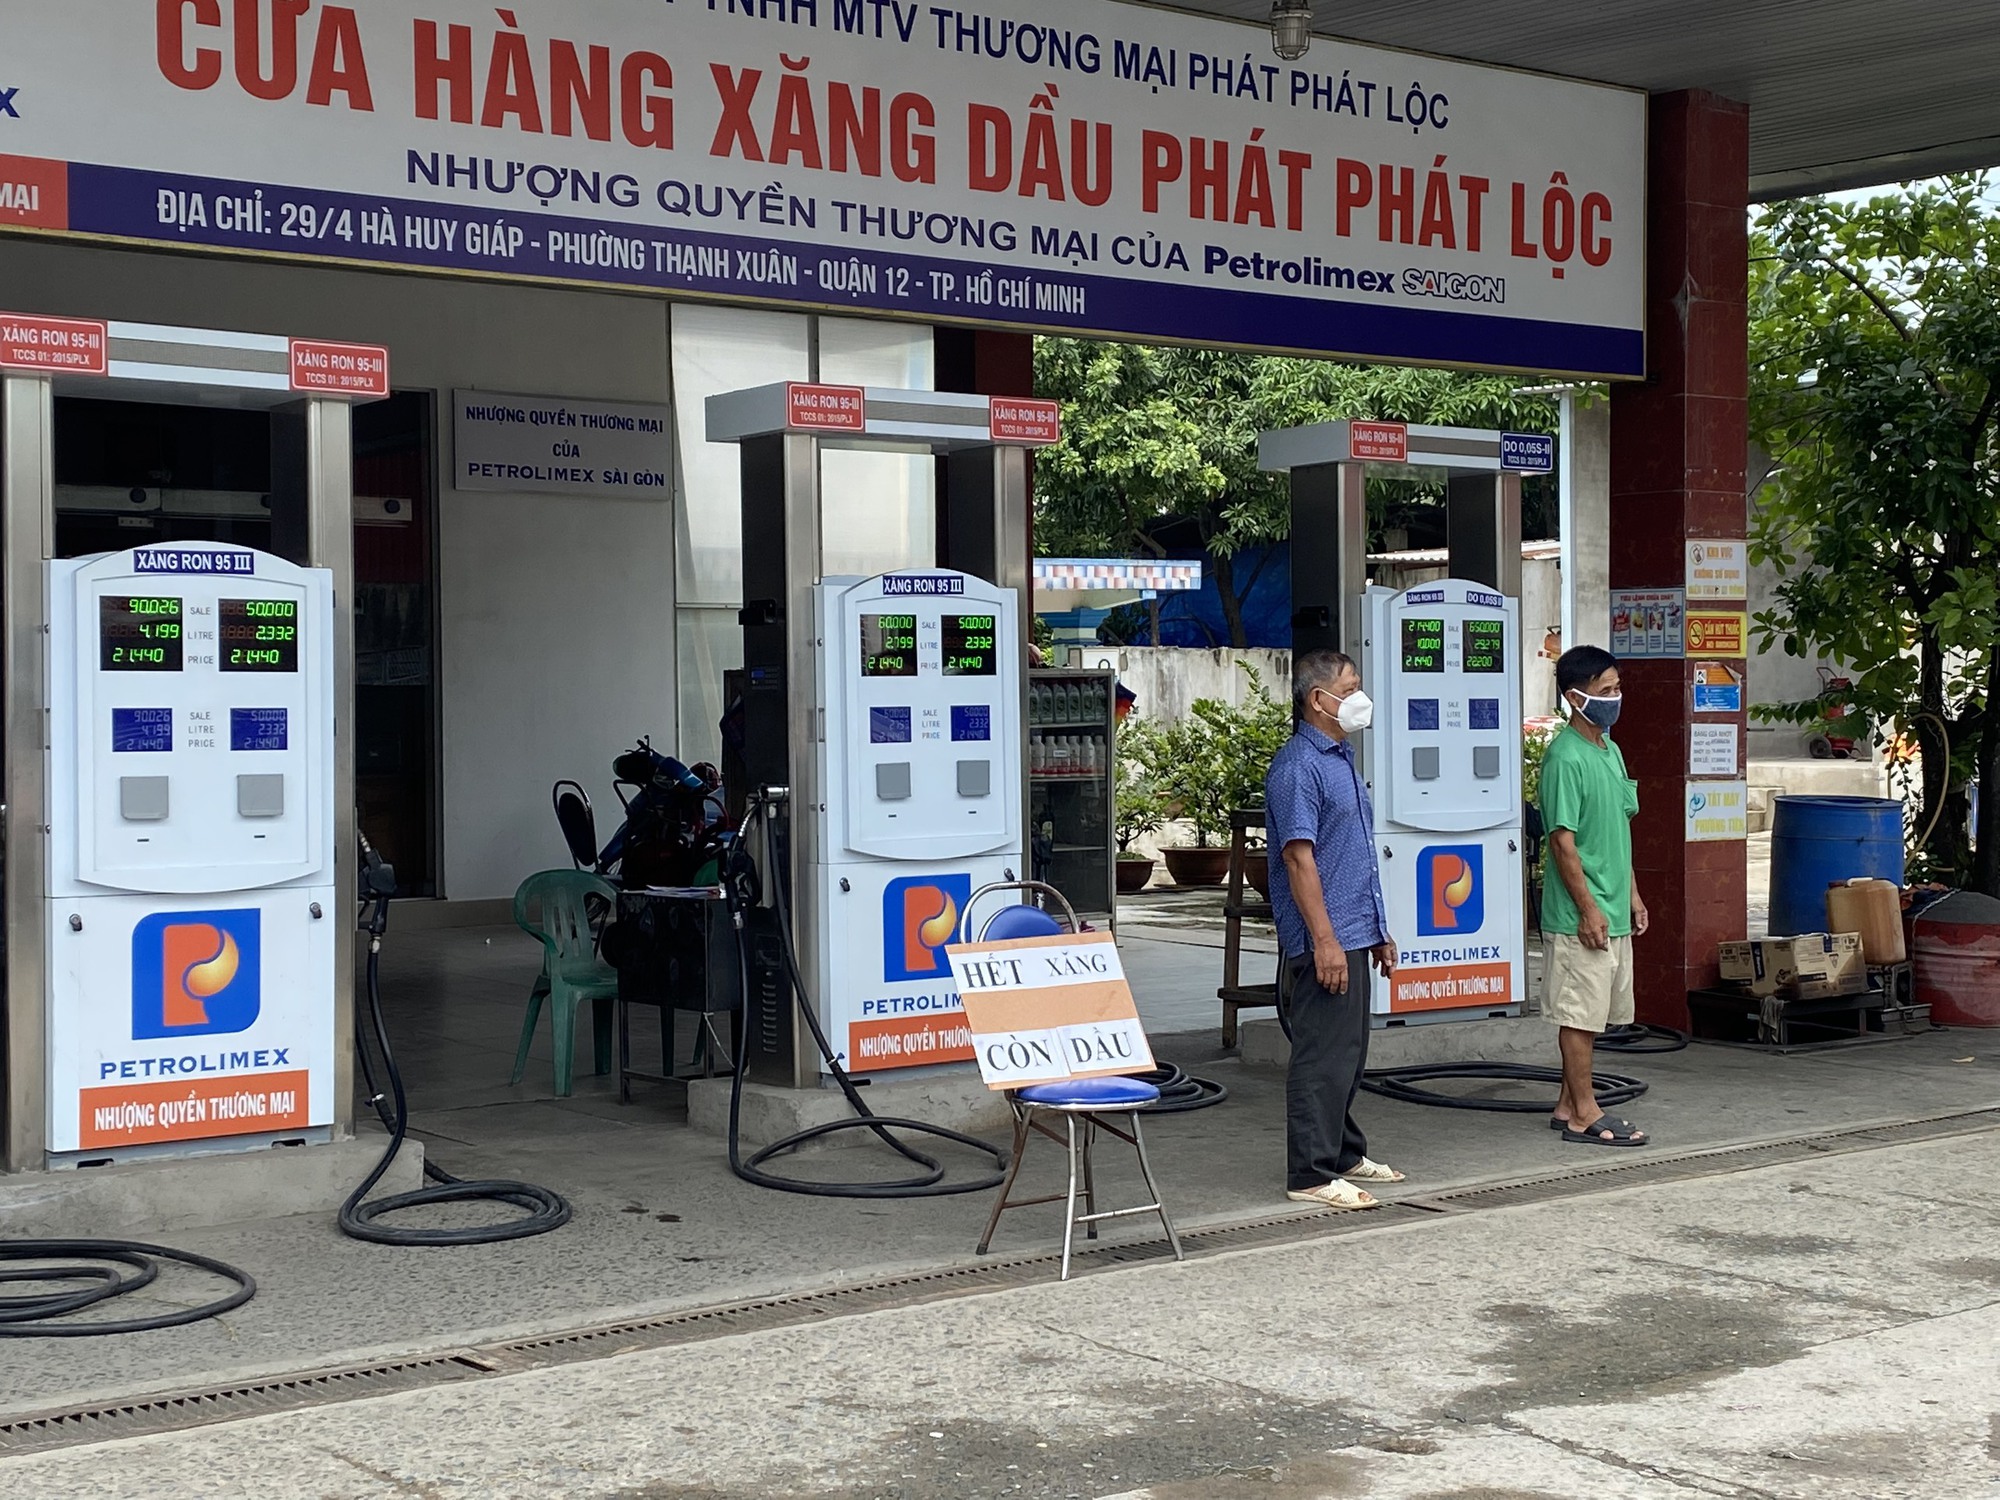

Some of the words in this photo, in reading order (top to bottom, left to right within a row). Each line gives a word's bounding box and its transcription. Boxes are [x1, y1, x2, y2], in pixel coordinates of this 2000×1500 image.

[834, 0, 917, 42] MTV
[930, 9, 1101, 74] THƯƠNG
[1114, 40, 1175, 94] MẠI
[1189, 53, 1280, 104] PHÁT
[1291, 70, 1376, 118] PHÁT
[1386, 82, 1449, 135] LỘC
[413, 8, 674, 150] HÀNG
[709, 53, 936, 185] XĂNG
[968, 83, 1112, 207] DẦU
[1142, 127, 1312, 231] PHÁT
[1336, 154, 1490, 252] PHÁT
[1511, 171, 1612, 279] LỘC
[407, 150, 640, 207] NHƯỢNG
[656, 181, 816, 228] QUYỀN
[832, 201, 1016, 252] THƯƠNG
[1031, 225, 1098, 267] MẠI
[1111, 231, 1189, 271] CỦA
[1204, 246, 1395, 294] Petrolimex
[1401, 267, 1505, 303] SAIGON
[157, 189, 209, 235] ĐỊA
[215, 189, 272, 235] CHỈ:
[280, 202, 353, 244] 29/4
[360, 203, 397, 247] HÀ
[405, 215, 457, 252] HUY
[464, 220, 524, 258] GIÁP
[548, 223, 645, 271] PHƯỜNG
[651, 241, 729, 287] THẠNH
[736, 248, 797, 286] XUÂN
[819, 256, 878, 297] QUẬN
[884, 267, 909, 297] 12
[929, 273, 960, 302] TP.
[966, 264, 992, 306] HỒ
[997, 275, 1030, 310] CHÍ
[1035, 284, 1085, 315] MINH
[3, 324, 38, 344] XĂNG
[42, 329, 68, 346] RON
[71, 333, 99, 348] 95-III
[12, 349, 36, 361] TCCS
[52, 352, 90, 365] 2015/PLX
[296, 349, 327, 368] XĂNG
[331, 355, 354, 370] RON
[357, 358, 382, 372] 95-III
[306, 372, 326, 384] TCCS
[793, 391, 817, 408] XĂNG
[820, 395, 838, 409] RON
[466, 405, 525, 426] NHƯỢNG
[529, 408, 576, 427] QUYỀN
[580, 413, 634, 431] THƯƠNG
[638, 419, 663, 435] MẠI
[995, 405, 1017, 421] XĂNG
[1018, 409, 1035, 422] RON
[552, 439, 580, 458] CỦA
[1504, 440, 1517, 452] DO
[468, 463, 595, 483] PETROLIMEX
[603, 468, 628, 485] SÀI
[633, 469, 664, 487] GÒN
[137, 550, 177, 570] XĂNG
[182, 556, 211, 571] RON
[215, 555, 231, 571] 95
[234, 555, 251, 571] III
[884, 577, 911, 593] XĂNG
[914, 579, 935, 593] RON
[937, 579, 948, 593] 95
[950, 579, 962, 593] III
[1468, 593, 1478, 602] DO
[190, 607, 211, 615] SALE
[188, 632, 213, 640] LITRE
[188, 656, 214, 664] PRICE
[190, 712, 211, 720] SALE
[188, 725, 214, 734] LITRE
[188, 739, 215, 748] PRICE
[1400, 946, 1500, 964] PETROLIMEX
[961, 952, 1024, 988] HẾT
[1046, 951, 1107, 977] XĂNG
[1398, 978, 1430, 1003] NHƯỢNG
[1431, 973, 1456, 1000] QUYỀN
[1458, 976, 1489, 995] THƯƠNG
[1490, 976, 1504, 996] MẠI
[863, 992, 963, 1015] PETROLIM
[859, 1030, 900, 1059] NHƯỢNG
[903, 1023, 935, 1053] QUYỀN
[938, 1026, 974, 1049] THƯƠN
[986, 1035, 1054, 1072] CÒN
[1070, 1026, 1134, 1064] DẦU
[100, 1048, 289, 1080] PETROLIMEX
[94, 1101, 155, 1134] NHƯỢNG
[158, 1090, 206, 1128] QUYỀN
[210, 1091, 266, 1120] THƯƠNG
[270, 1090, 295, 1118] MẠI
